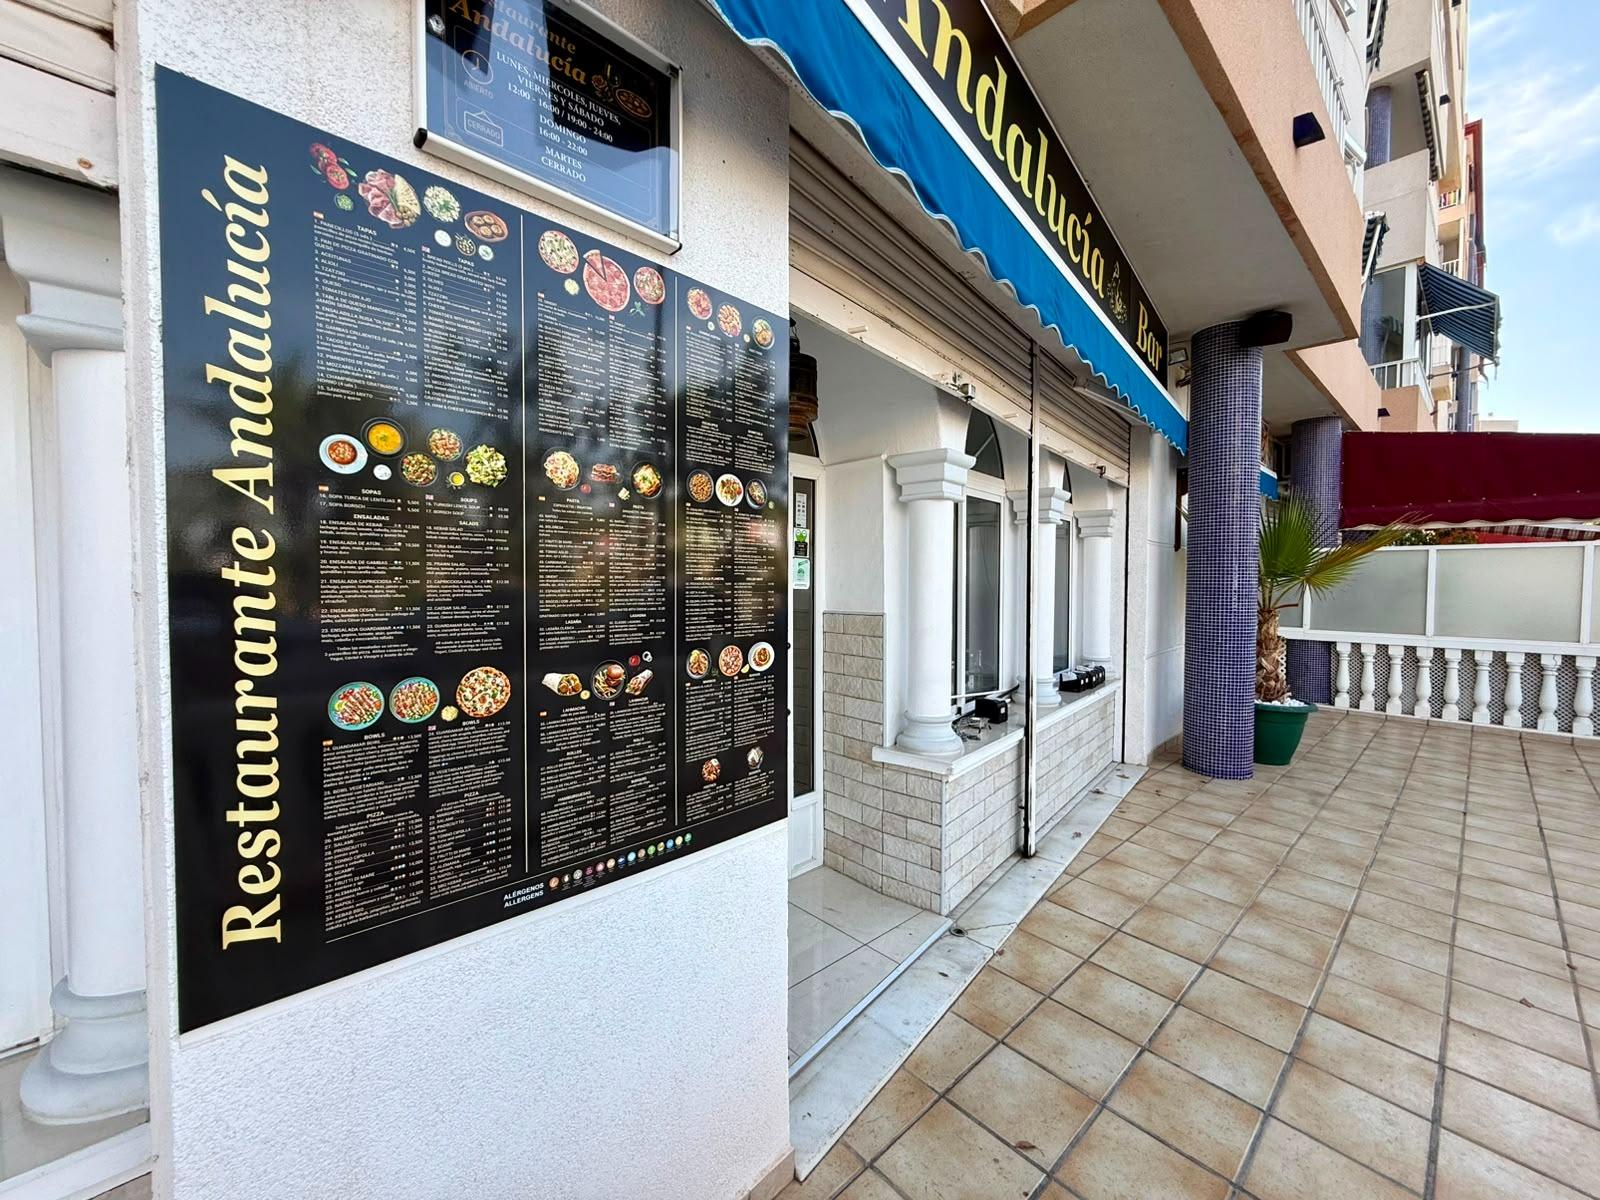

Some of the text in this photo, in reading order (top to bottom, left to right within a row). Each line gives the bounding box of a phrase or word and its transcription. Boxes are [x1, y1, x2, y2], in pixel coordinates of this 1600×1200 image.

[496, 51, 532, 77] LUNES,
[588, 100, 622, 126] JUEVES,
[507, 82, 531, 101] 12:00
[538, 98, 560, 116] 16:00
[566, 112, 588, 130] 19:00
[593, 127, 614, 144] 24:00
[517, 76, 605, 128] VIERNES Y SÁBADO
[467, 117, 501, 139] CERRADO
[539, 114, 587, 145] DOMINGO
[538, 126, 561, 144] 16:00
[567, 139, 588, 157] 22:00
[545, 146, 583, 169] MARTES
[541, 156, 587, 183] CERRADO
[357, 225, 376, 236] TAPAS
[457, 257, 474, 267] TAPAS
[1136, 301, 1163, 372] Bar
[201, 154, 282, 950] Restaurante Andalucía
[363, 732, 385, 740] BOWLS
[463, 790, 479, 798] PIZZA
[366, 810, 384, 818] PIZZA
[503, 882, 545, 901] ALÉRGENOS
[503, 889, 545, 909] ALLERGENS
